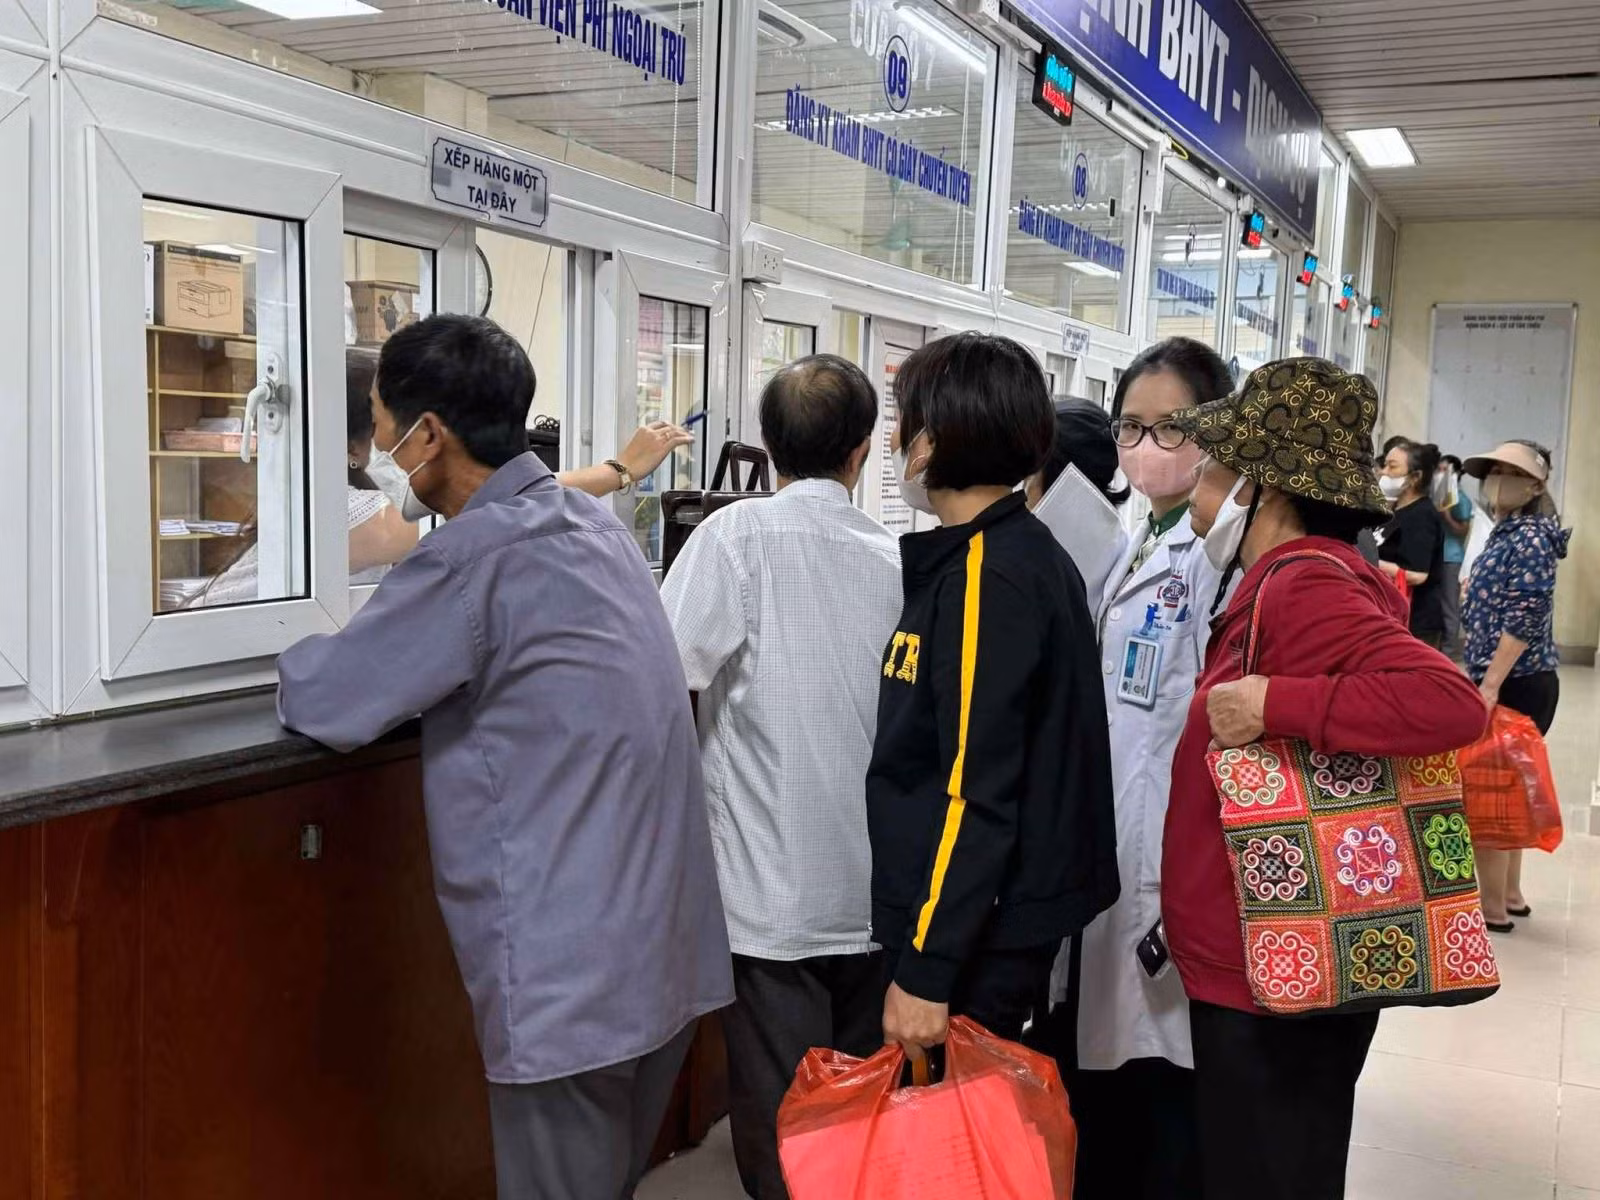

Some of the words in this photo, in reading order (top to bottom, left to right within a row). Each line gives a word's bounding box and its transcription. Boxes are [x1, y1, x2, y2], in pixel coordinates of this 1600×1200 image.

[612, 3, 656, 81] NGOẠI
[661, 23, 686, 86] TRÚ
[1159, 0, 1230, 124] BHYT
[888, 50, 907, 99] 09
[786, 83, 815, 142] ĐĂNG
[832, 107, 860, 161] KHÁM
[862, 125, 885, 171] BHYT
[886, 130, 897, 177] CÓ
[444, 146, 470, 170] XẾP
[474, 156, 511, 183] HÀNG
[513, 168, 539, 193] MỘT
[1075, 165, 1086, 198] 08
[467, 185, 488, 208] TẠI
[491, 191, 517, 213] ĐÂY
